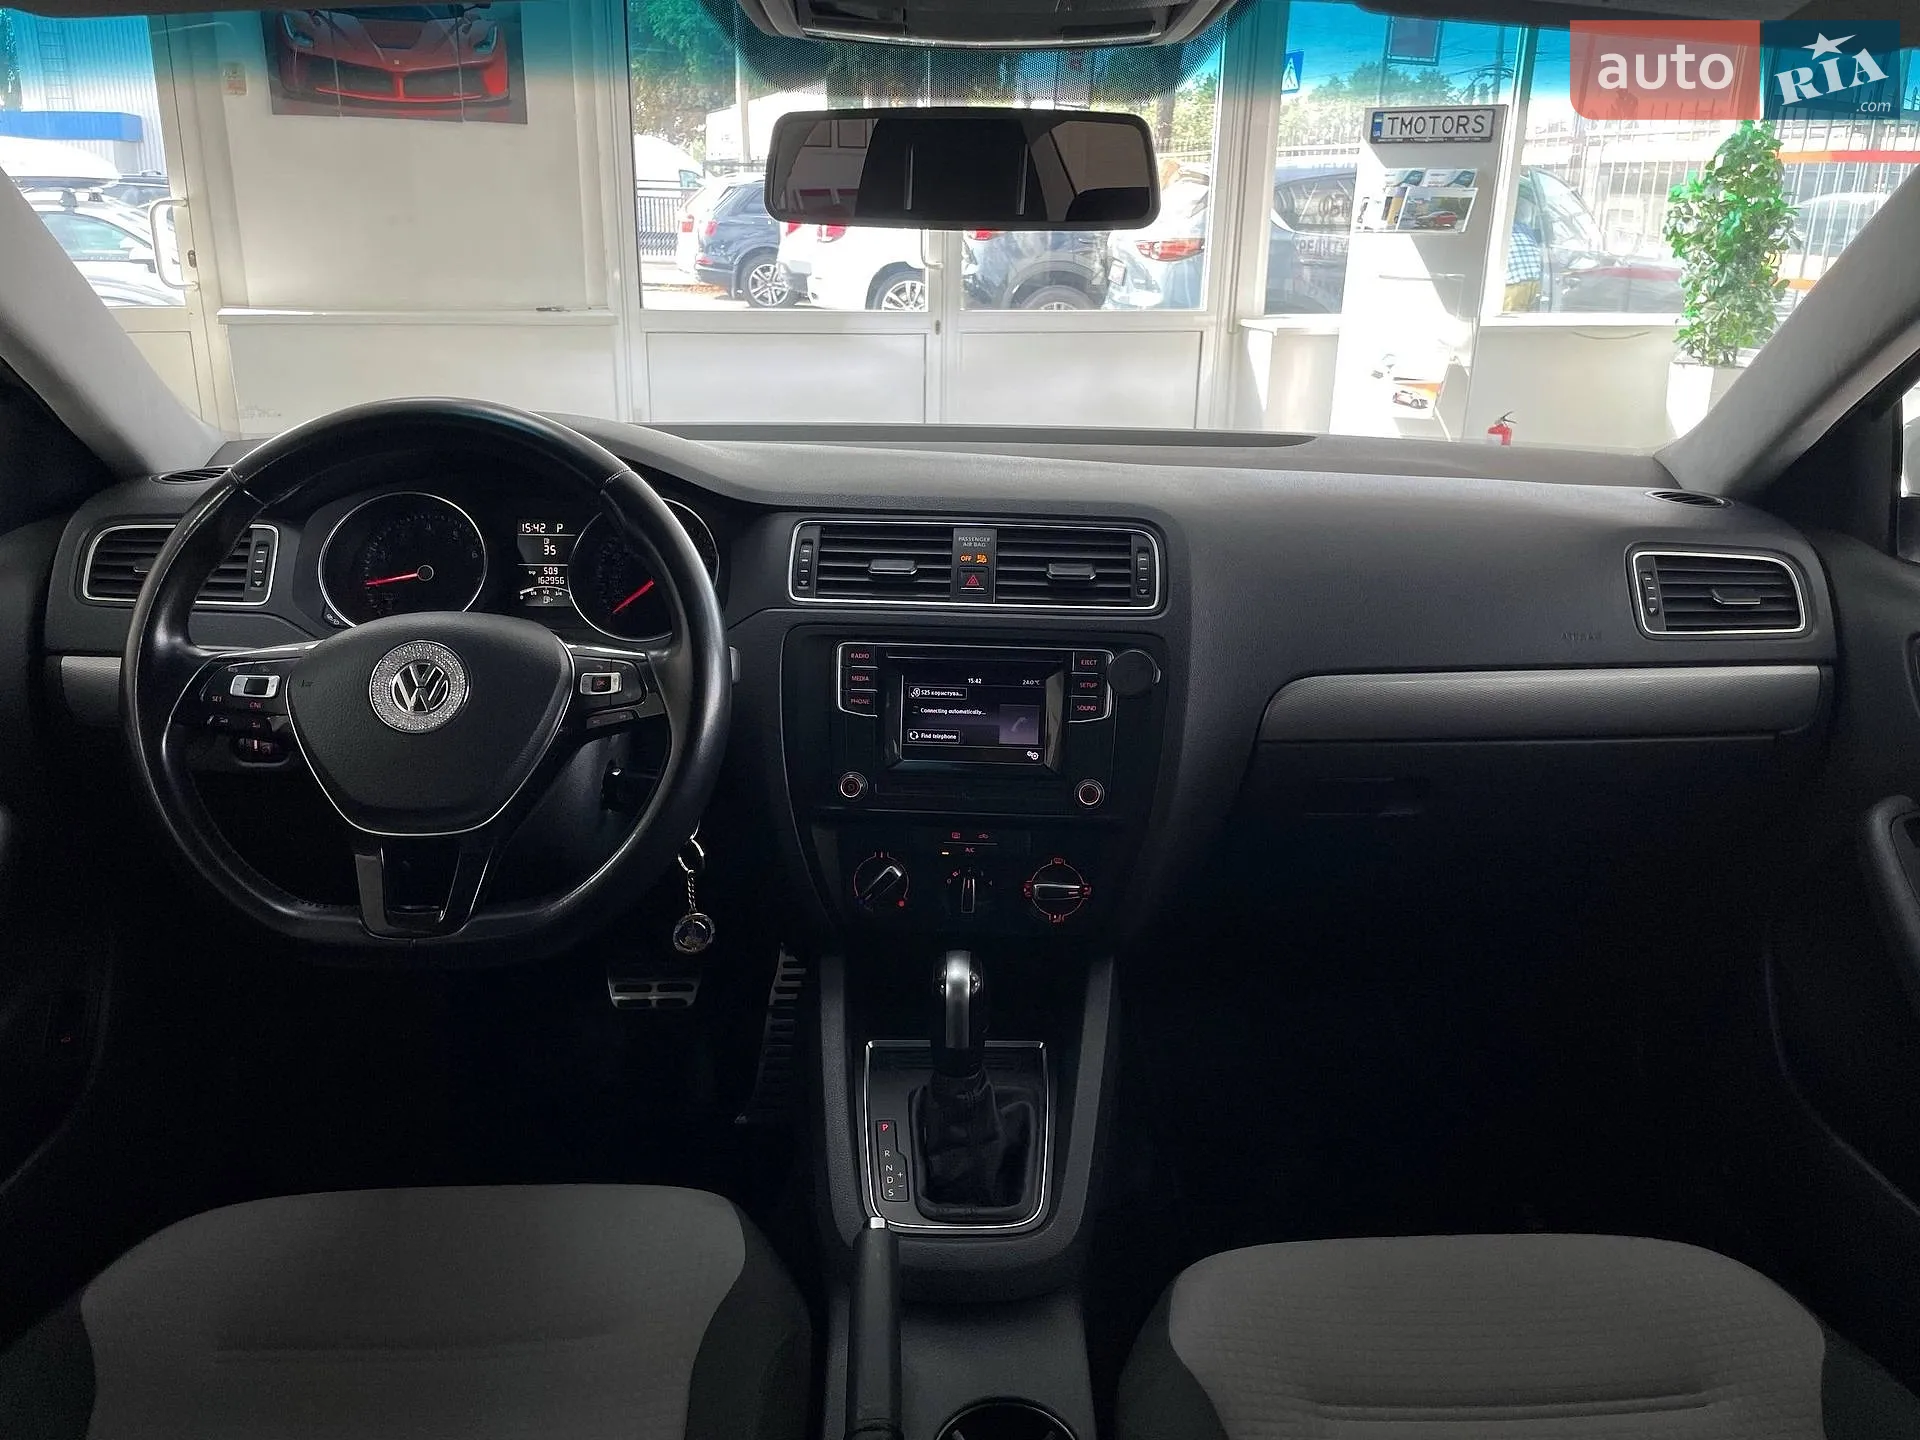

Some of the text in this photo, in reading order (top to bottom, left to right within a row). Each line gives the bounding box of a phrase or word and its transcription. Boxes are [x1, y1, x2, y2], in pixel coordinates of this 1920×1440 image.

[1387, 114, 1486, 136] TMOTORS
[521, 523, 564, 533] 15:42 P
[543, 545, 557, 556] 35
[967, 677, 982, 685] 15:42
[920, 707, 948, 716] Connecting
[932, 733, 957, 741] telephone
[882, 1123, 889, 1131] P
[884, 1149, 891, 1157] R
[885, 1164, 893, 1172] N
[886, 1176, 894, 1184] D
[888, 1188, 895, 1197] S
